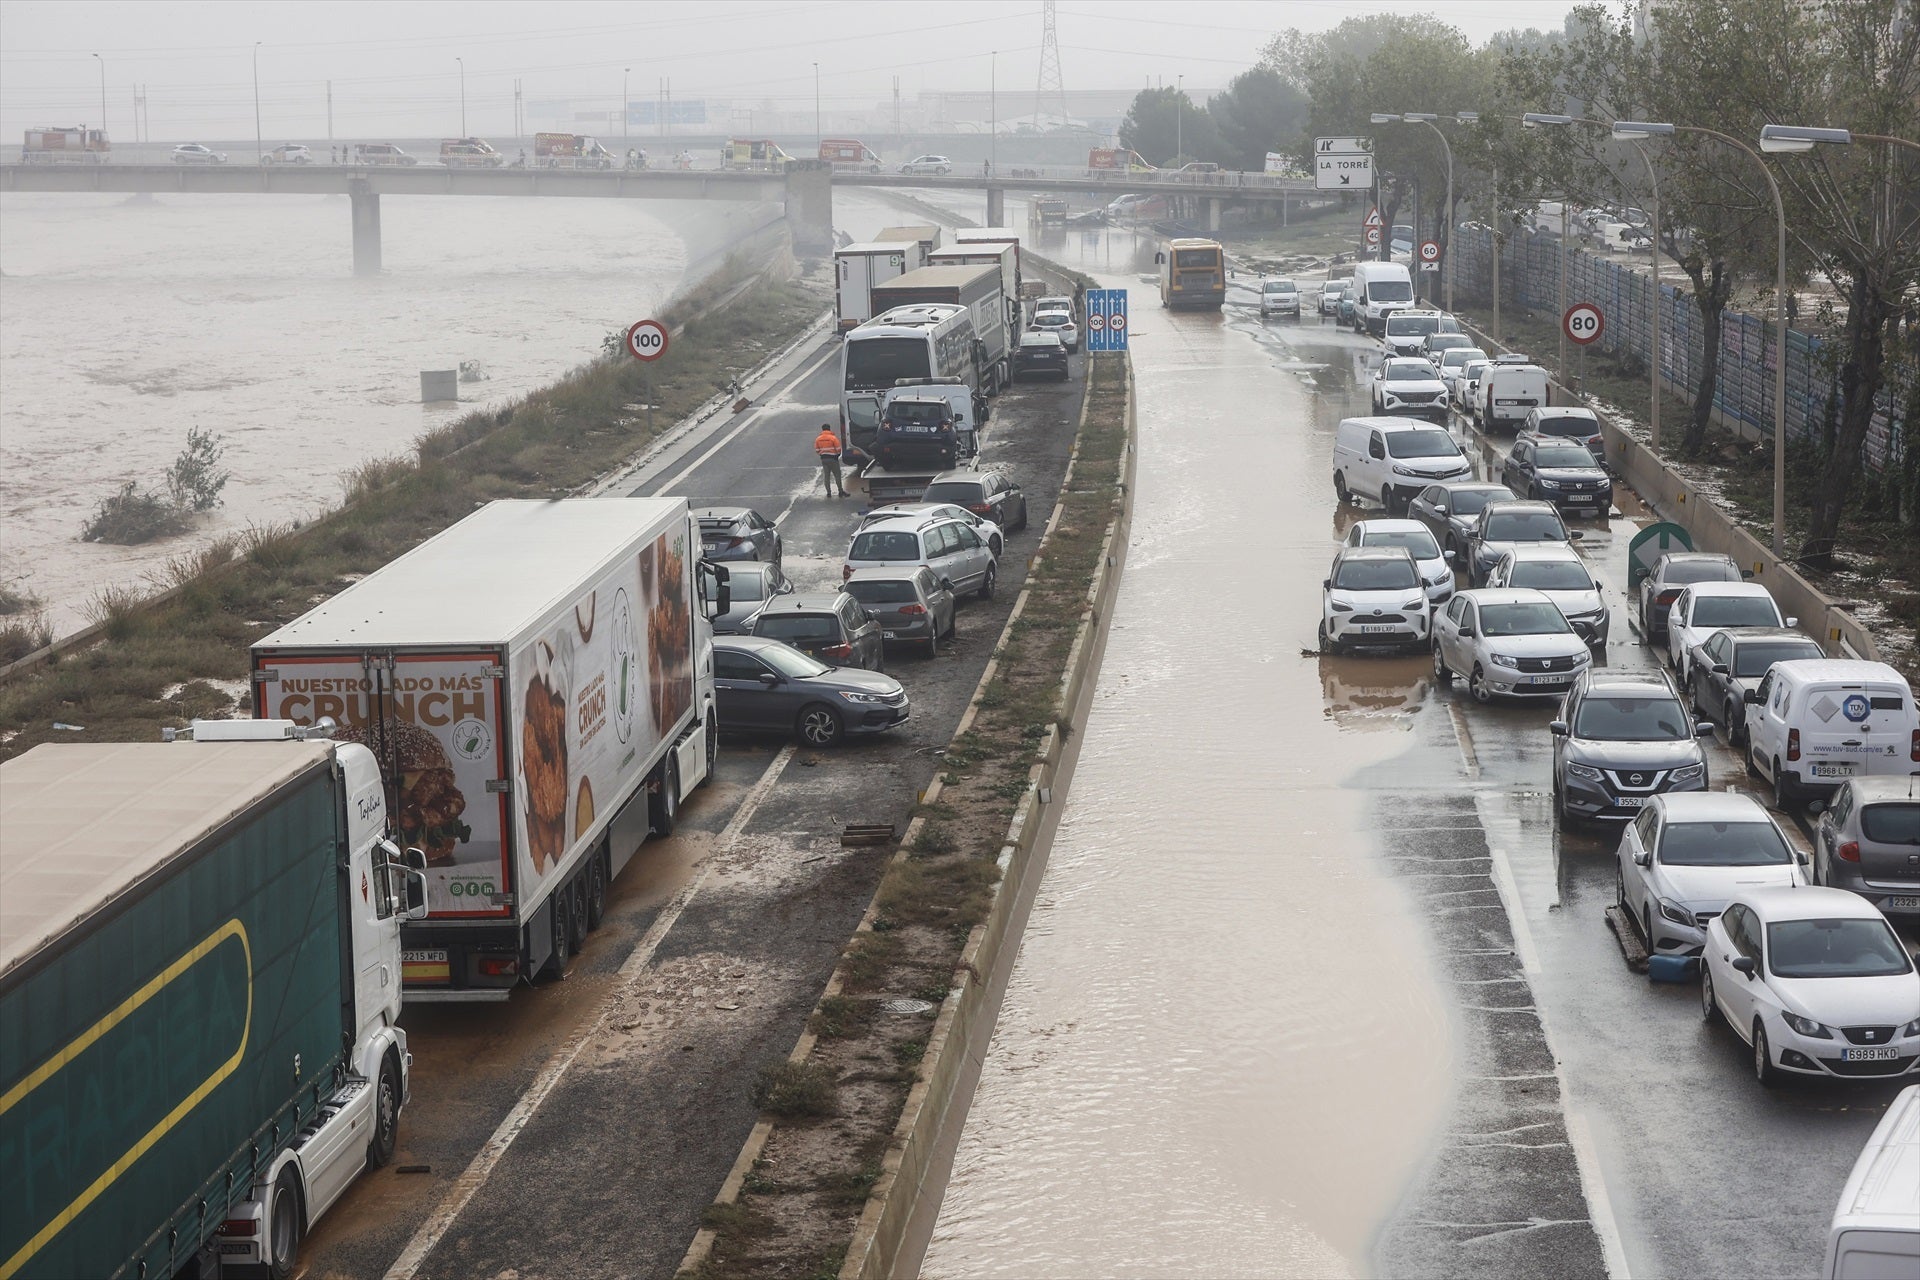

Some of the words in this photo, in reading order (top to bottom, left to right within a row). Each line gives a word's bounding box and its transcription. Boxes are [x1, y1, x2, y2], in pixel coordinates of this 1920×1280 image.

[1320, 161, 1331, 169] LA
[1337, 161, 1369, 169] TORRE
[1424, 247, 1436, 255] 60
[890, 256, 900, 267] 9
[1572, 316, 1596, 331] 80
[634, 333, 661, 348] 100
[281, 678, 373, 693] NUESTRO
[380, 677, 434, 691] LADO
[439, 673, 483, 691] MÁS
[279, 692, 486, 728] CRUNCH
[578, 685, 606, 735] CRUNCH
[1813, 745, 1883, 753] www.tuv-sud.com/es
[1817, 767, 1837, 775] 9968
[1838, 767, 1853, 775] LTX
[1620, 798, 1639, 806] 3552
[1894, 897, 1918, 907] 2326
[403, 952, 426, 961] 2215
[427, 951, 445, 960] MFD
[1849, 1049, 1875, 1060] 6989
[1877, 1048, 1897, 1059] HKD
